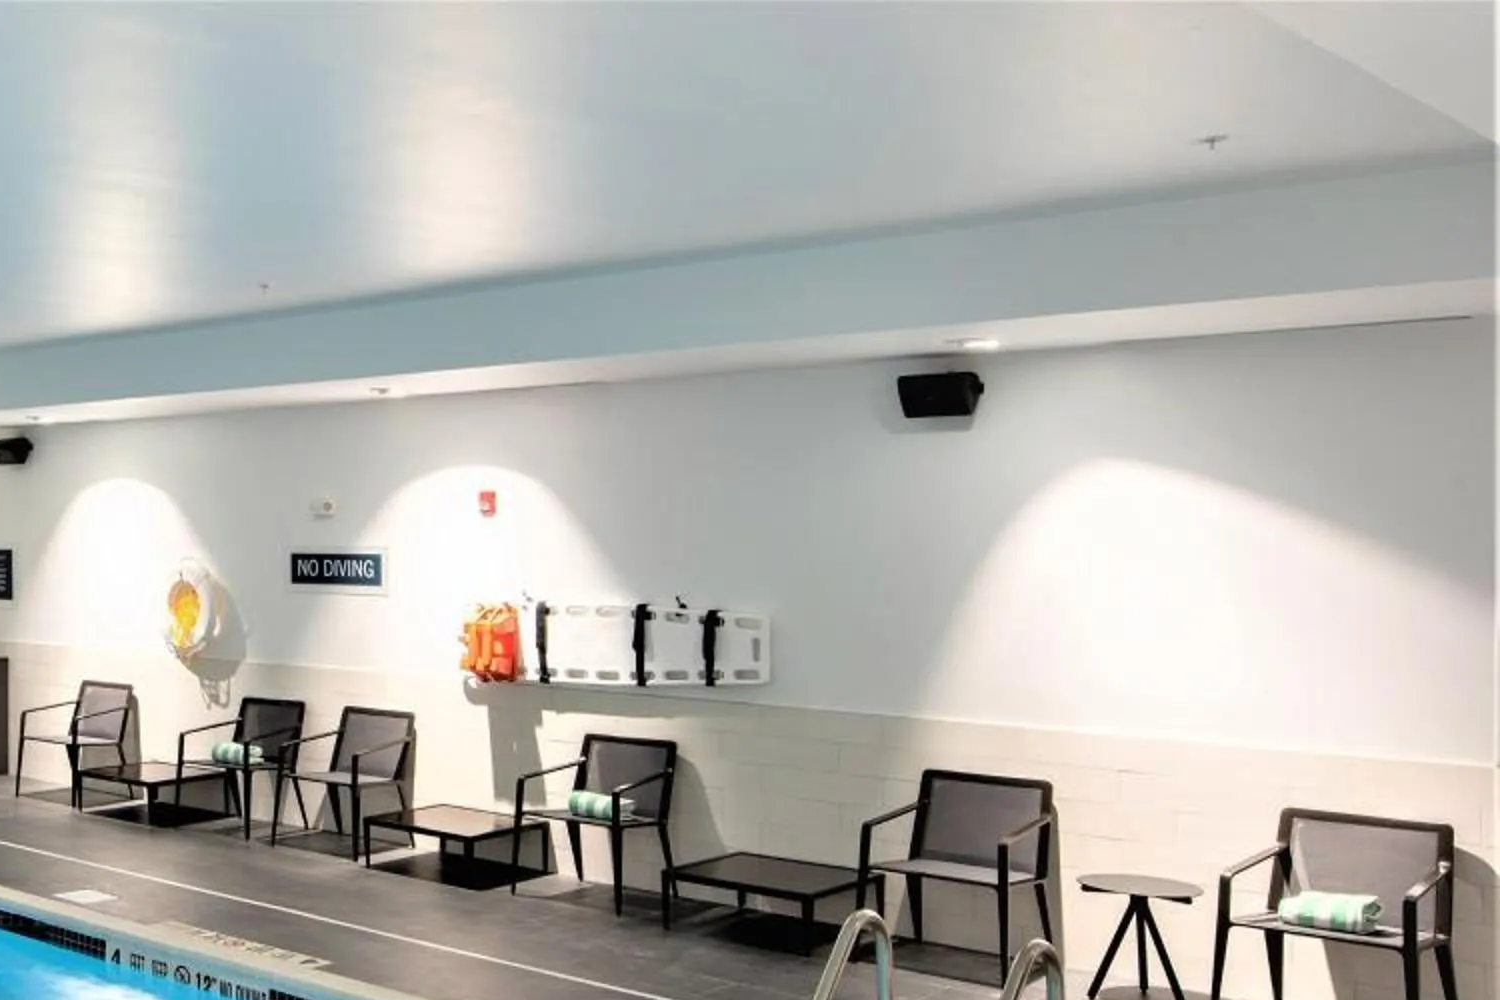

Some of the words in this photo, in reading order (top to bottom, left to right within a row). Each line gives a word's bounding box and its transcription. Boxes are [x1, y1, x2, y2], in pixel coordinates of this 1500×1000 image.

[297, 559, 319, 577] NO
[323, 559, 376, 579] DIVING
[111, 947, 121, 966] 4
